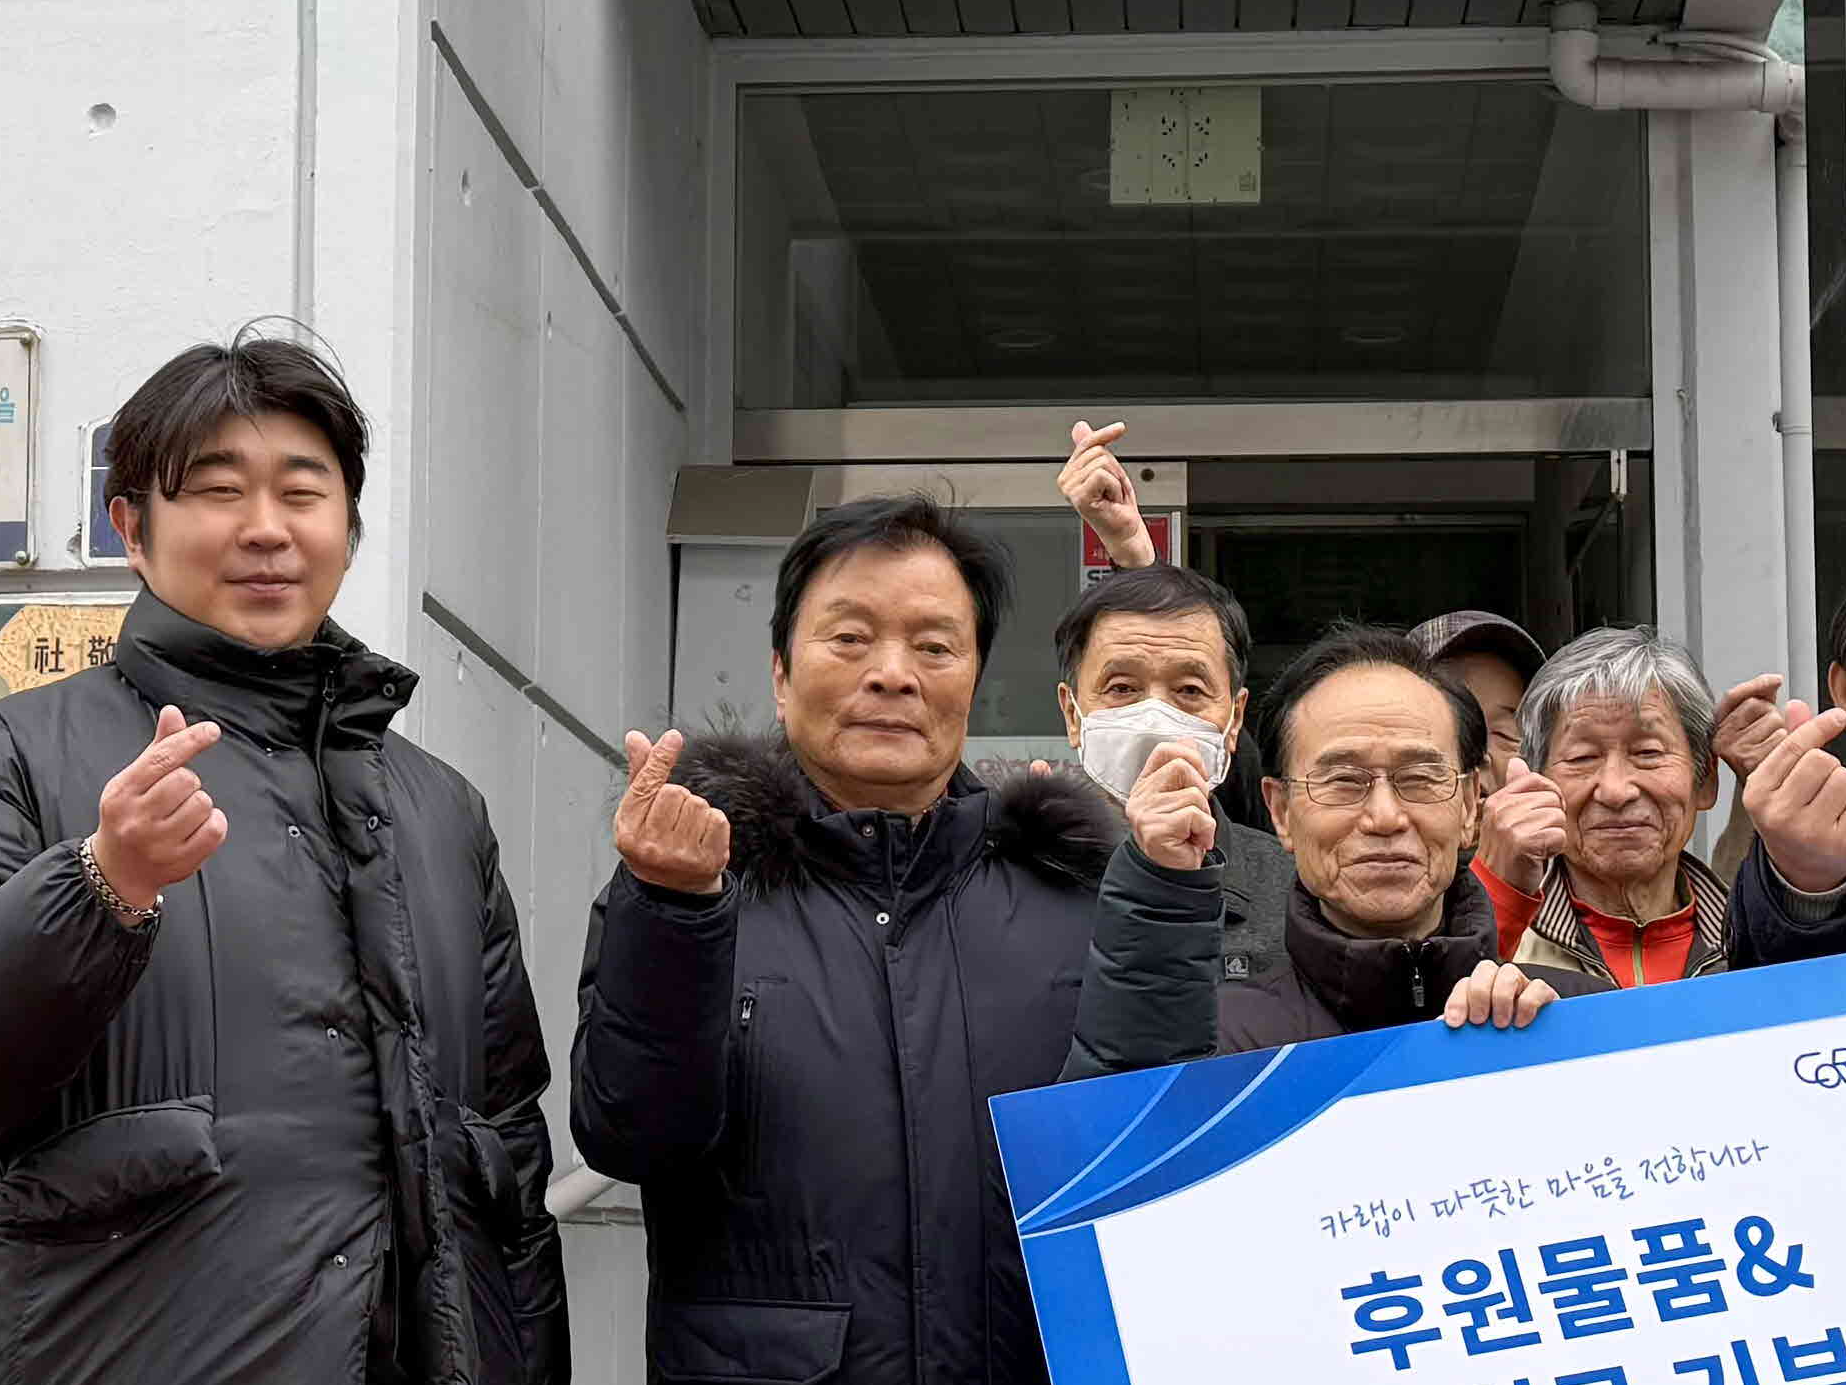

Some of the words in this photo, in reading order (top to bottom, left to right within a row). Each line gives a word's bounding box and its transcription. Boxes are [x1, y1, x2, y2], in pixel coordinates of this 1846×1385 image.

[1320, 1198, 1416, 1239] 카랩이
[1432, 1176, 1534, 1219] 따뜻한
[1547, 1156, 1635, 1200] 마음을
[1639, 1139, 1770, 1183] 전합니다
[1341, 1216, 1815, 1371] 후원물품&
